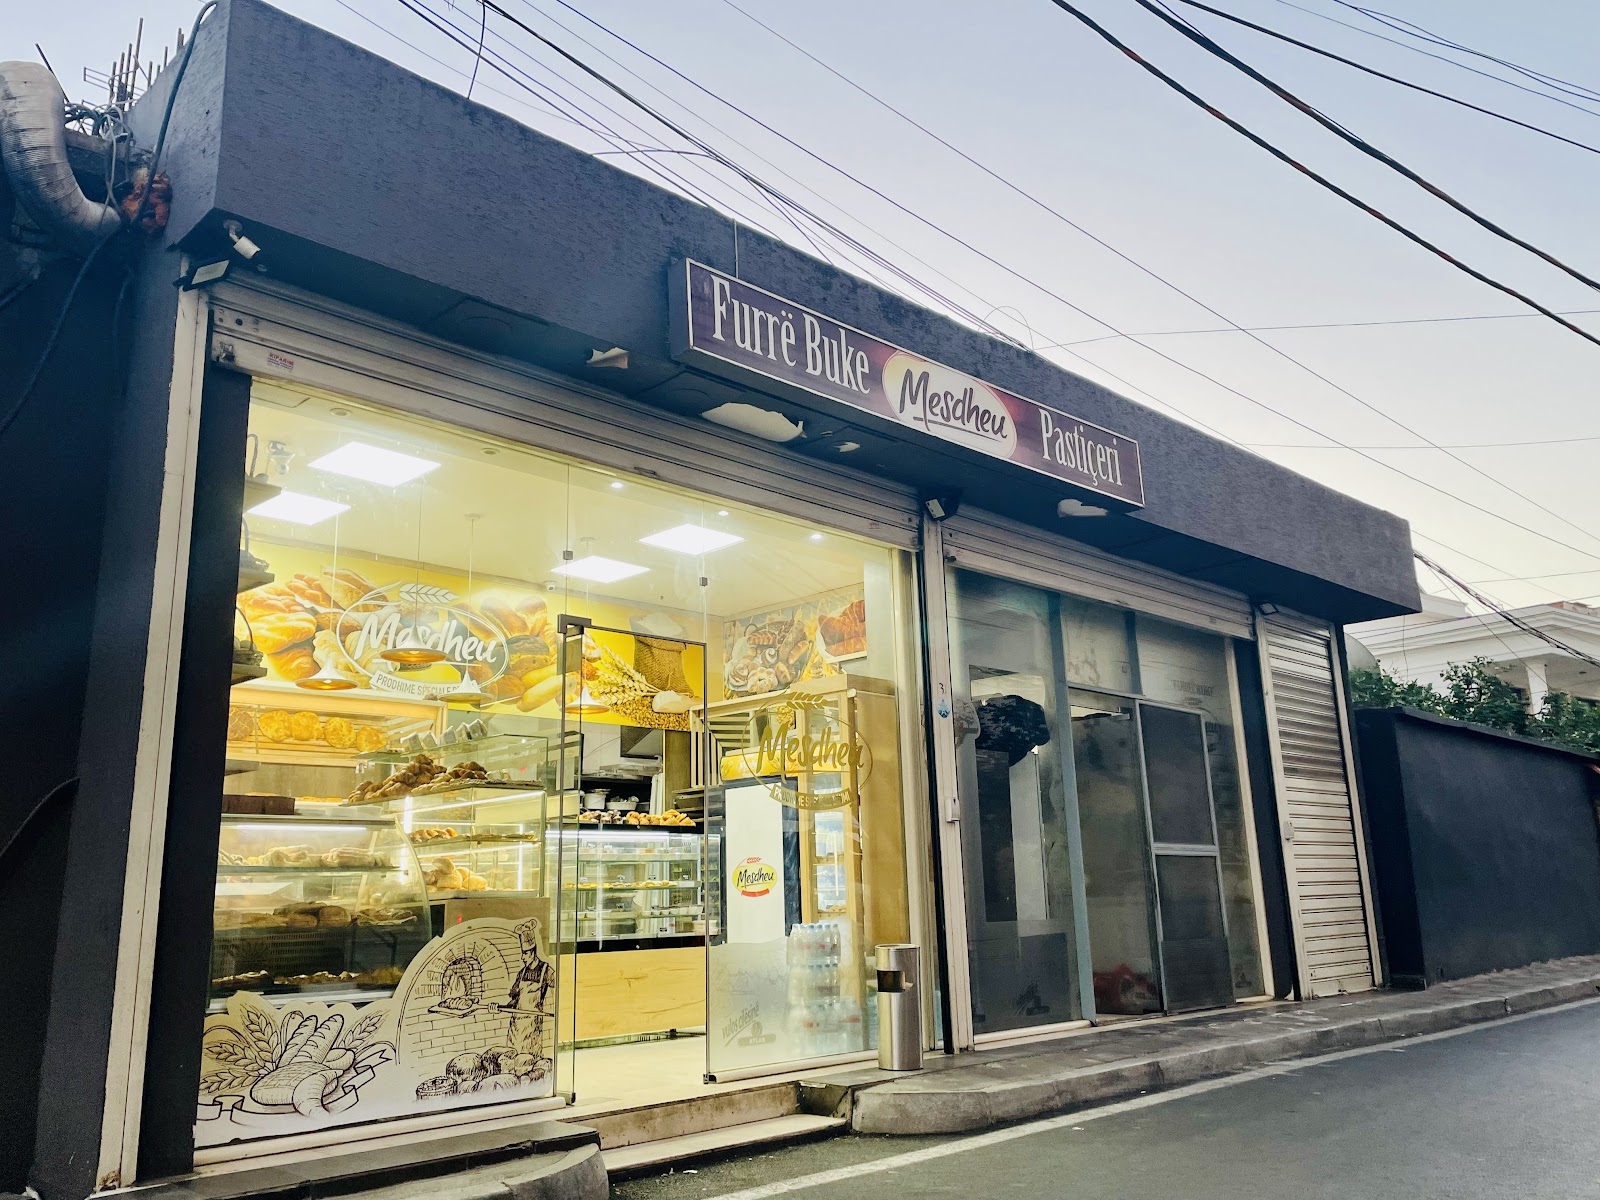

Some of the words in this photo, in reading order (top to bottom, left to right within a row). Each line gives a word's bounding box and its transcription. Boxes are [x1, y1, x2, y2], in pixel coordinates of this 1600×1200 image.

[710, 274, 797, 367] Furrë
[802, 313, 871, 395] Buke
[899, 368, 1008, 439] Mesdheu
[1038, 408, 1123, 486] Pastiçeri
[376, 673, 415, 695] PRODHIME
[737, 867, 774, 889] Mesdheu
